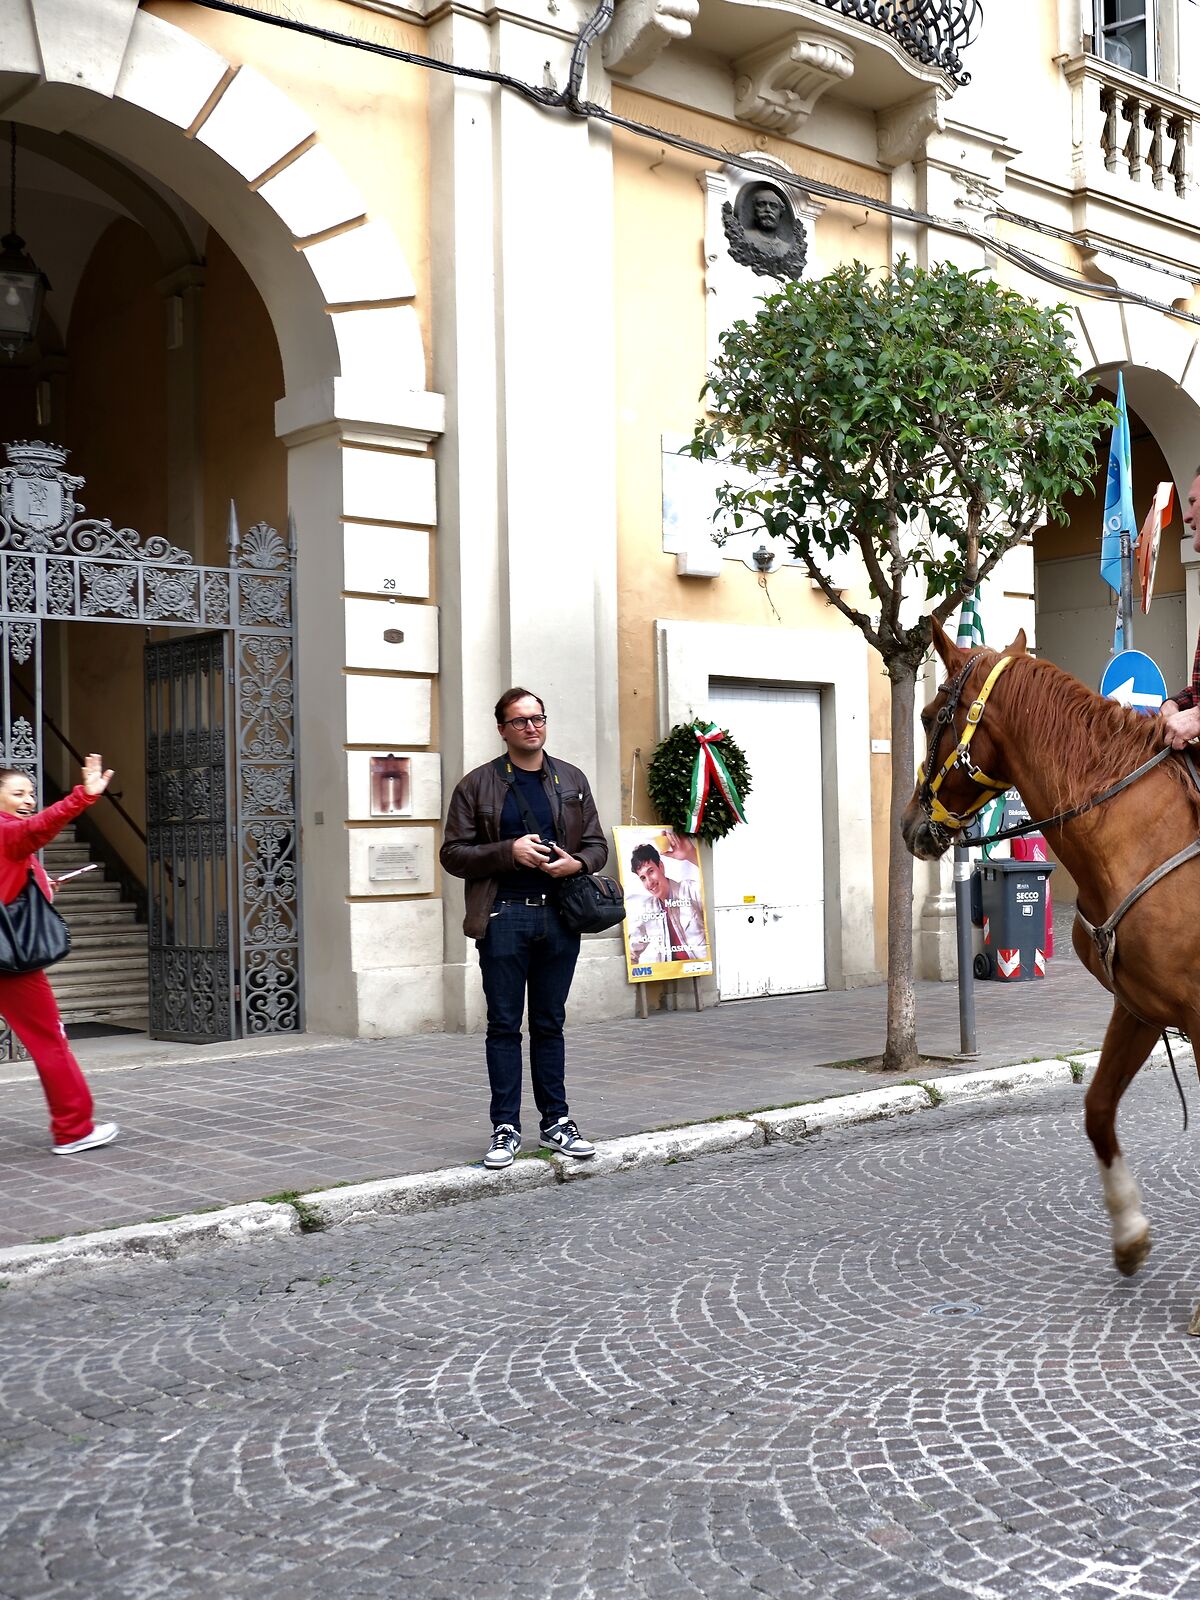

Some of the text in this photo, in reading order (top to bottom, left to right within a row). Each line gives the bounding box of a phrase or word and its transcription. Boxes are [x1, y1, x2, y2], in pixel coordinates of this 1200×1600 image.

[383, 578, 396, 589] 29
[1016, 891, 1040, 900] SECCO
[632, 966, 653, 977] AVIS
